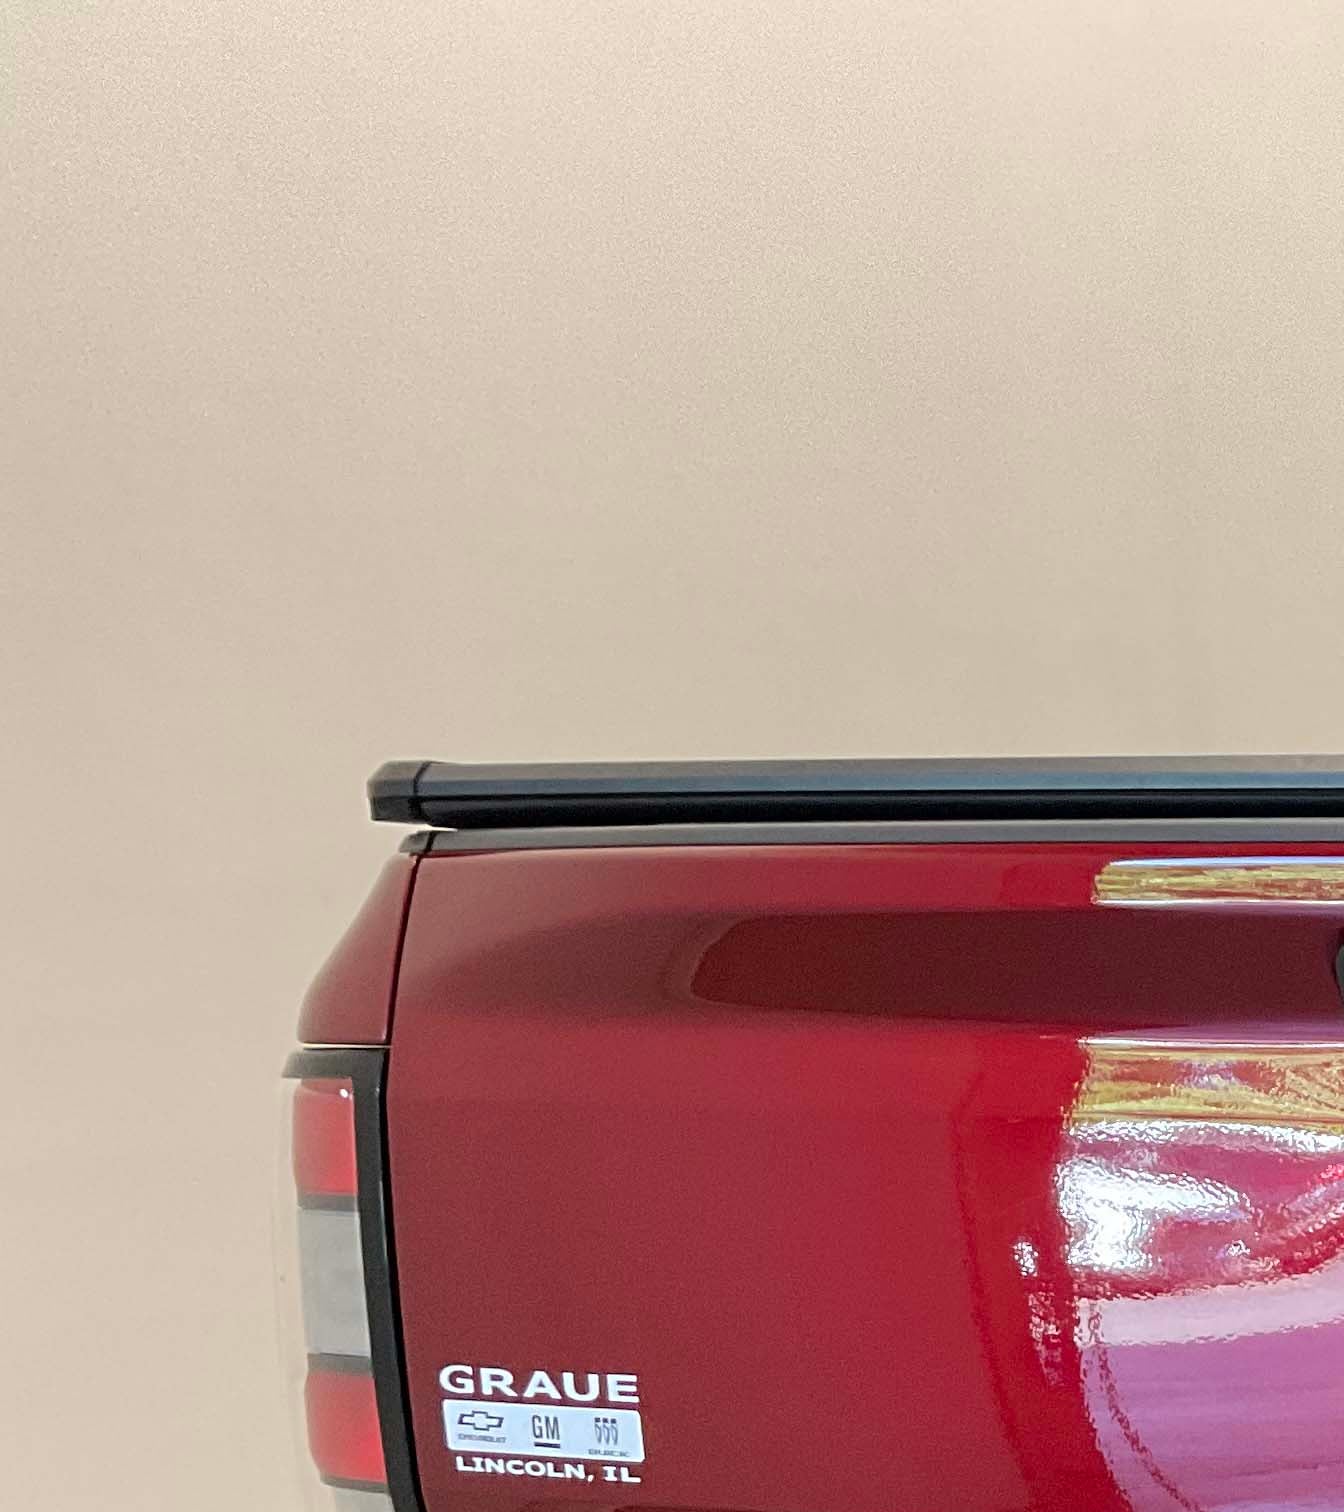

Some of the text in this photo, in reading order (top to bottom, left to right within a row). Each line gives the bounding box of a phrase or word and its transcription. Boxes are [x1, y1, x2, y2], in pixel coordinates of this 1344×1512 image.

[439, 1365, 640, 1403] GRAUE
[532, 1414, 561, 1441] GM
[455, 1455, 641, 1483] LINCOLN, IL
